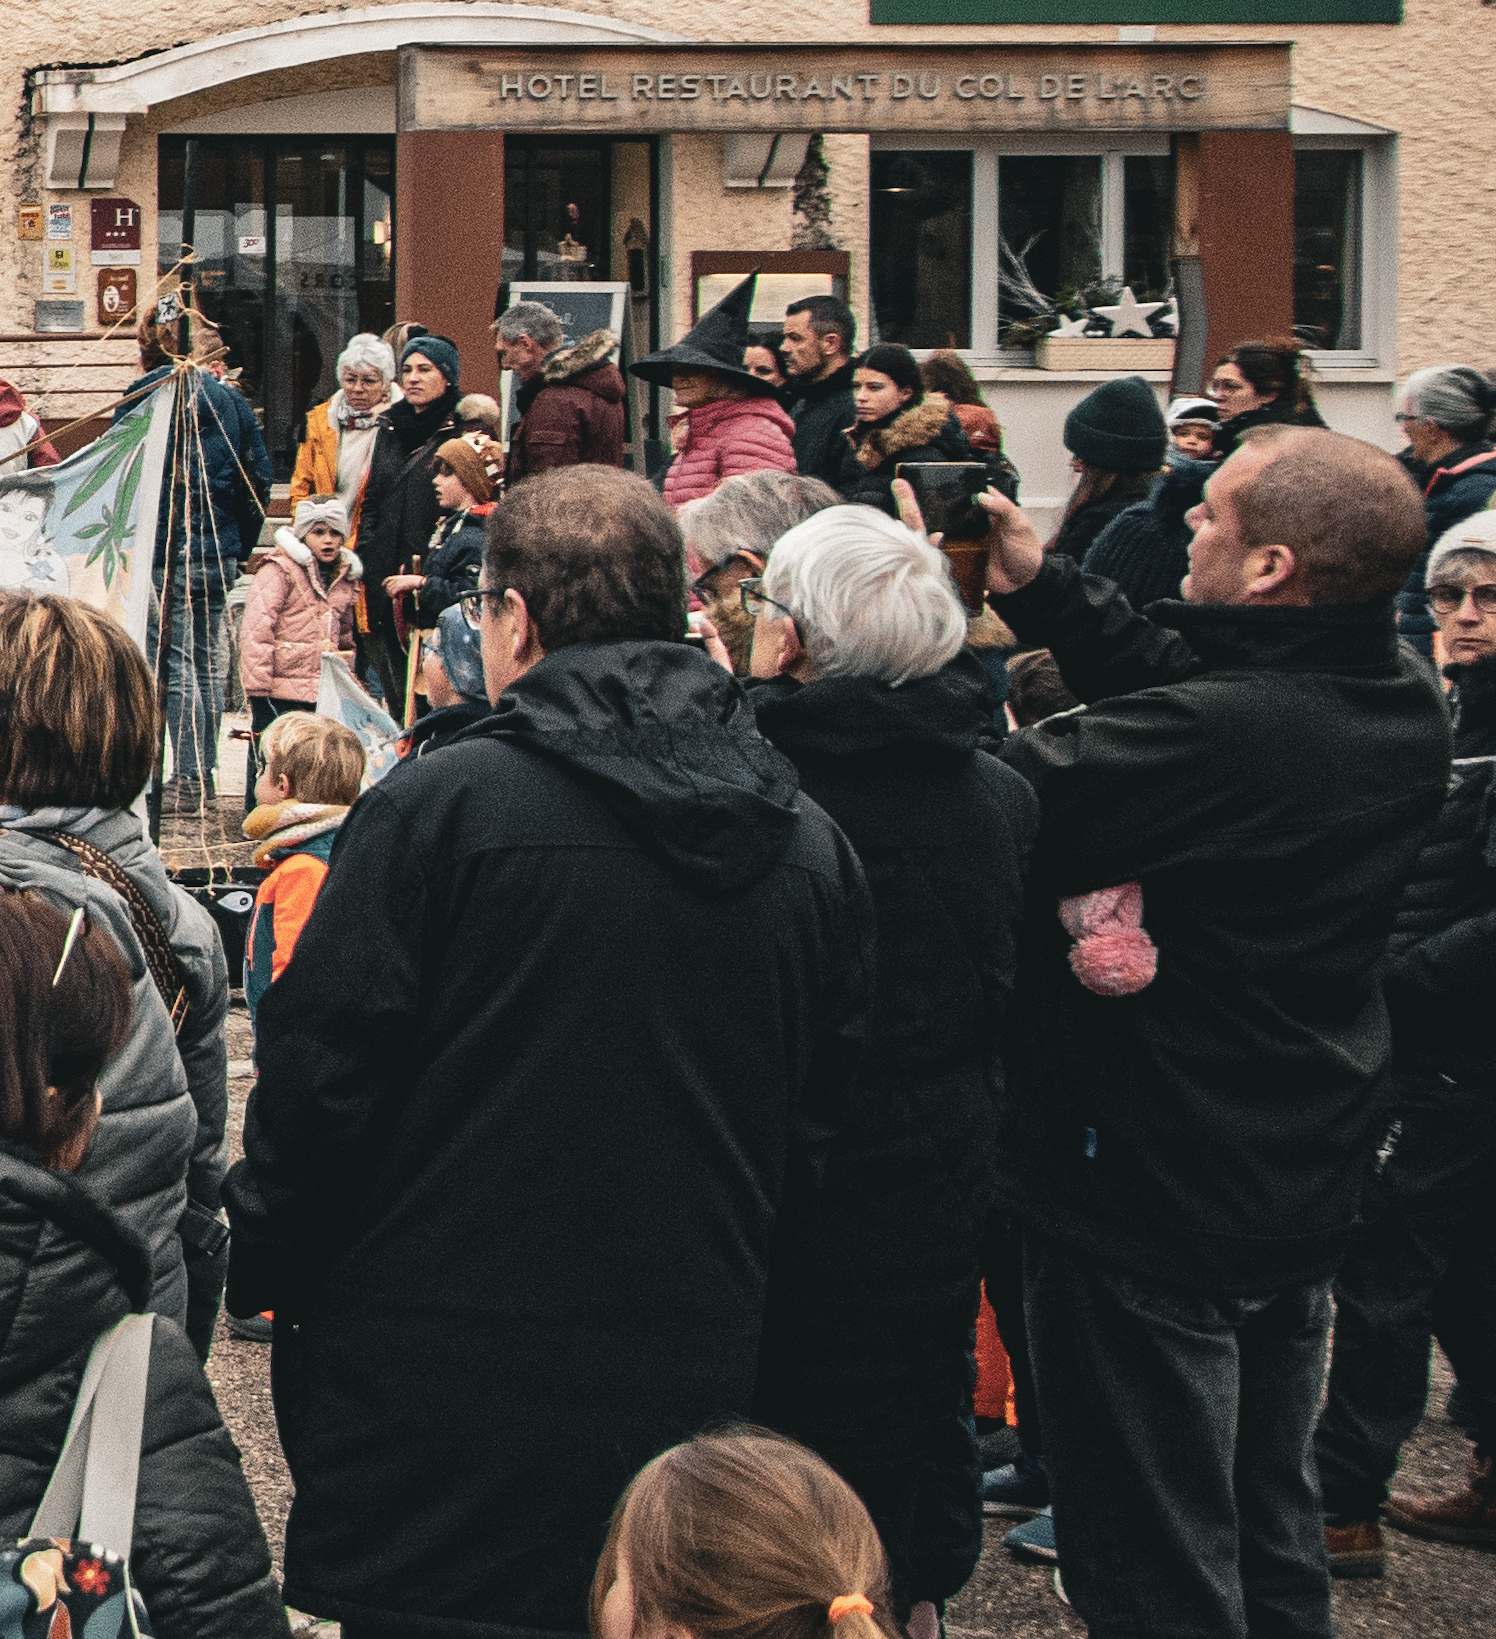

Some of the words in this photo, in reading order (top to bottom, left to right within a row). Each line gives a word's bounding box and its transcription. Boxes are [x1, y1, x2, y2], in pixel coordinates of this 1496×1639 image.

[500, 73, 618, 100] HOTEL
[630, 72, 879, 100] RESTAURANT
[890, 73, 940, 100] DU
[955, 73, 1024, 100] COL
[1039, 73, 1087, 100] DE
[1097, 73, 1202, 100] L'ARC
[114, 207, 134, 227] H
